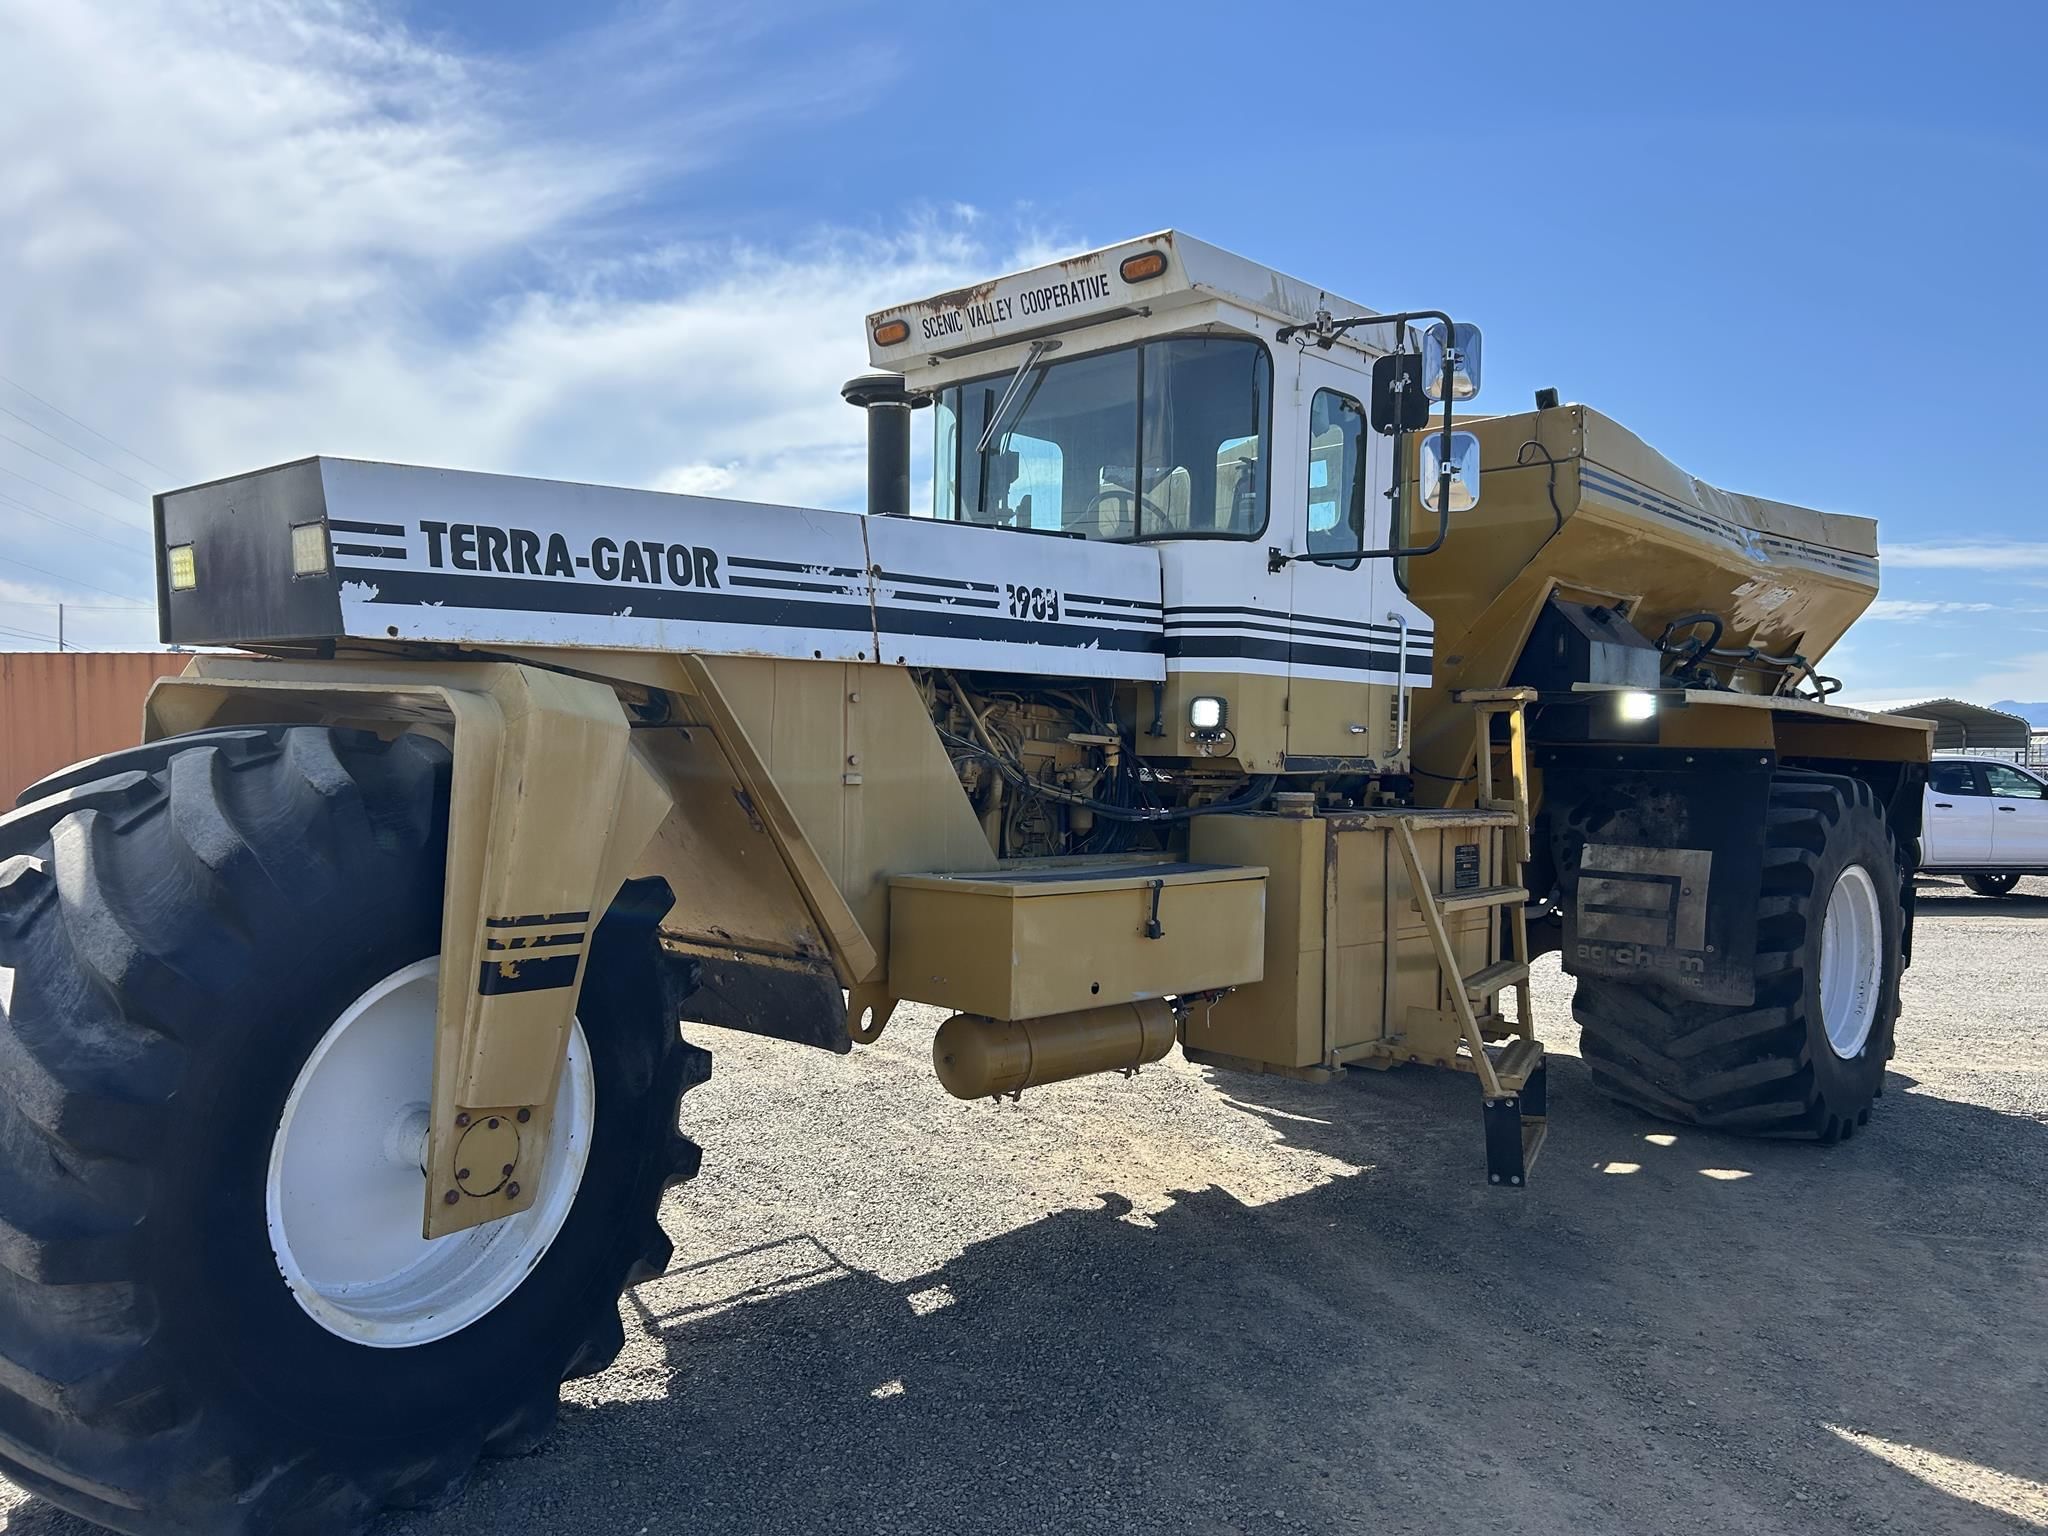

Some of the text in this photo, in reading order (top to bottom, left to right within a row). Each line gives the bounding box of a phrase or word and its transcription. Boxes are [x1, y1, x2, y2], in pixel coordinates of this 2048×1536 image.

[922, 273, 1110, 339] SCENIC VALLEY COOPERATIVE
[419, 520, 721, 589] TERRA-GATOR
